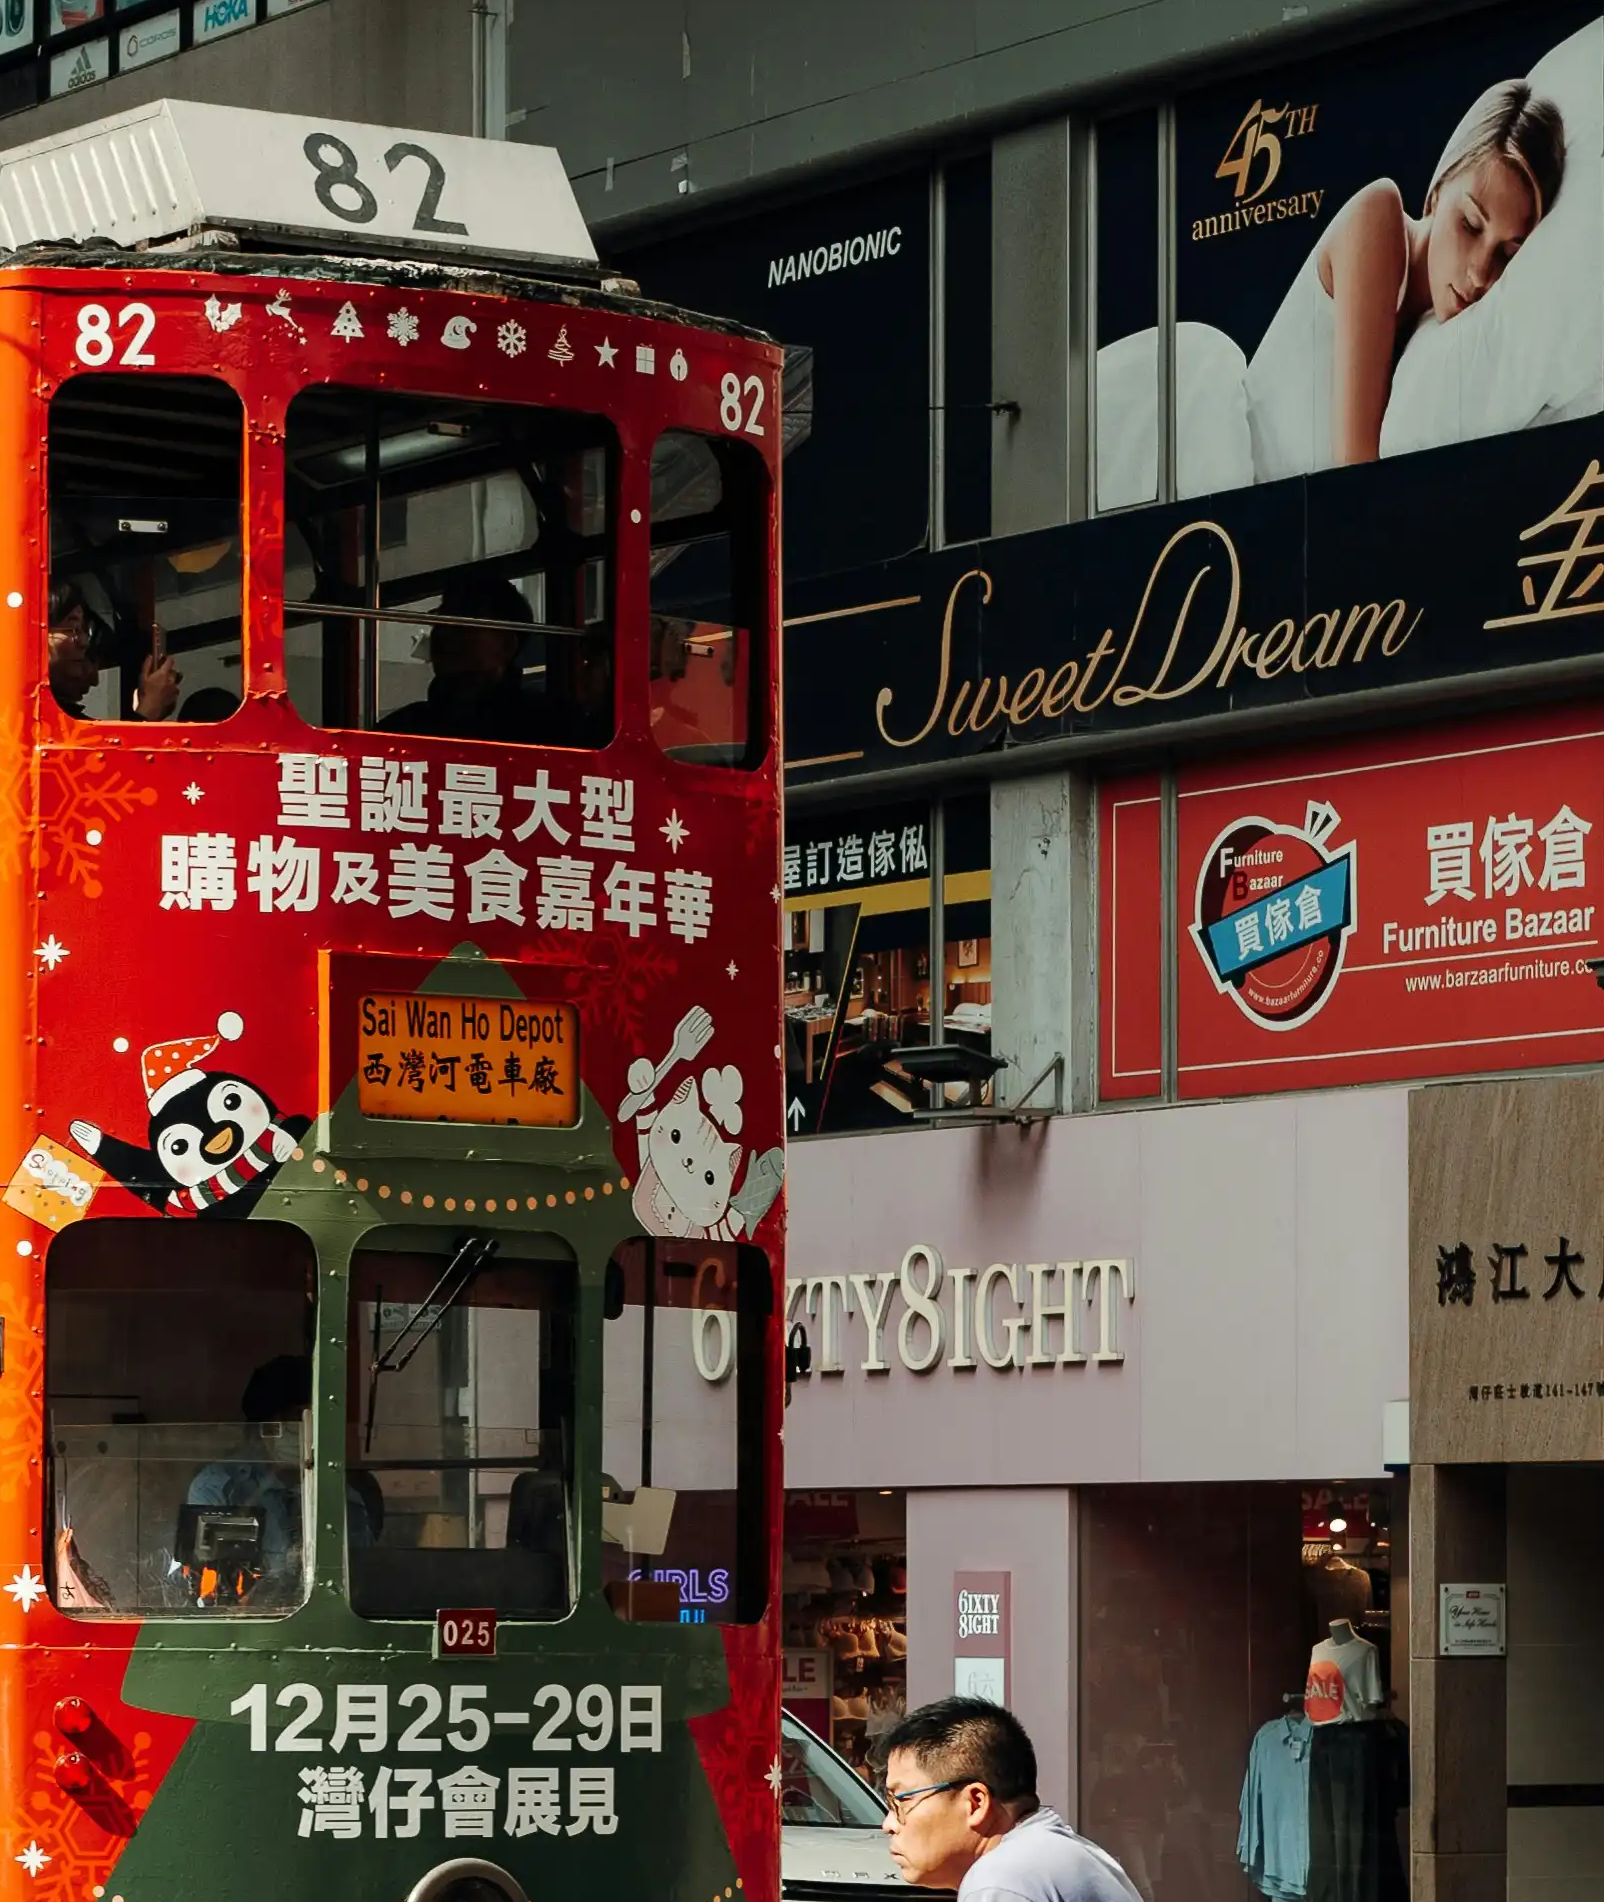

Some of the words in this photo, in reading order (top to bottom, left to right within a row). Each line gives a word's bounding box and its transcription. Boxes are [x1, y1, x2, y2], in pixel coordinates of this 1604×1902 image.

[68, 70, 96, 90] adidas
[303, 132, 469, 236] 82
[1192, 186, 1326, 242] anniversary
[767, 225, 903, 289] NANOBIONIC
[75, 302, 156, 367] 82
[719, 371, 766, 437] 82
[876, 570, 1118, 748] Sweet
[1114, 521, 1424, 708] Dream
[276, 752, 636, 853] 聖誕最大型
[1220, 846, 1284, 879] Furniture
[1232, 870, 1284, 902] Bazaar
[1424, 803, 1593, 907] 買傢倉
[160, 835, 714, 945] 購物及美食嘉年華
[1233, 884, 1324, 961] 買傢倉
[1383, 915, 1497, 954] Furniture
[1505, 904, 1596, 942] Bazaar
[362, 998, 396, 1038] Sai
[406, 1000, 452, 1040] Wan
[460, 1002, 490, 1042] Ho
[499, 1004, 564, 1049] Depot
[362, 1048, 565, 1098] 西灣河電車廠
[1436, 1236, 1604, 1307] 鴻江大
[443, 1620, 490, 1647] 025
[958, 1589, 1000, 1615] 6IXTY
[958, 1613, 1000, 1639] 8IGHT
[230, 1683, 663, 1754] 12月25-29日
[297, 1765, 619, 1840] 灣仔會展見
